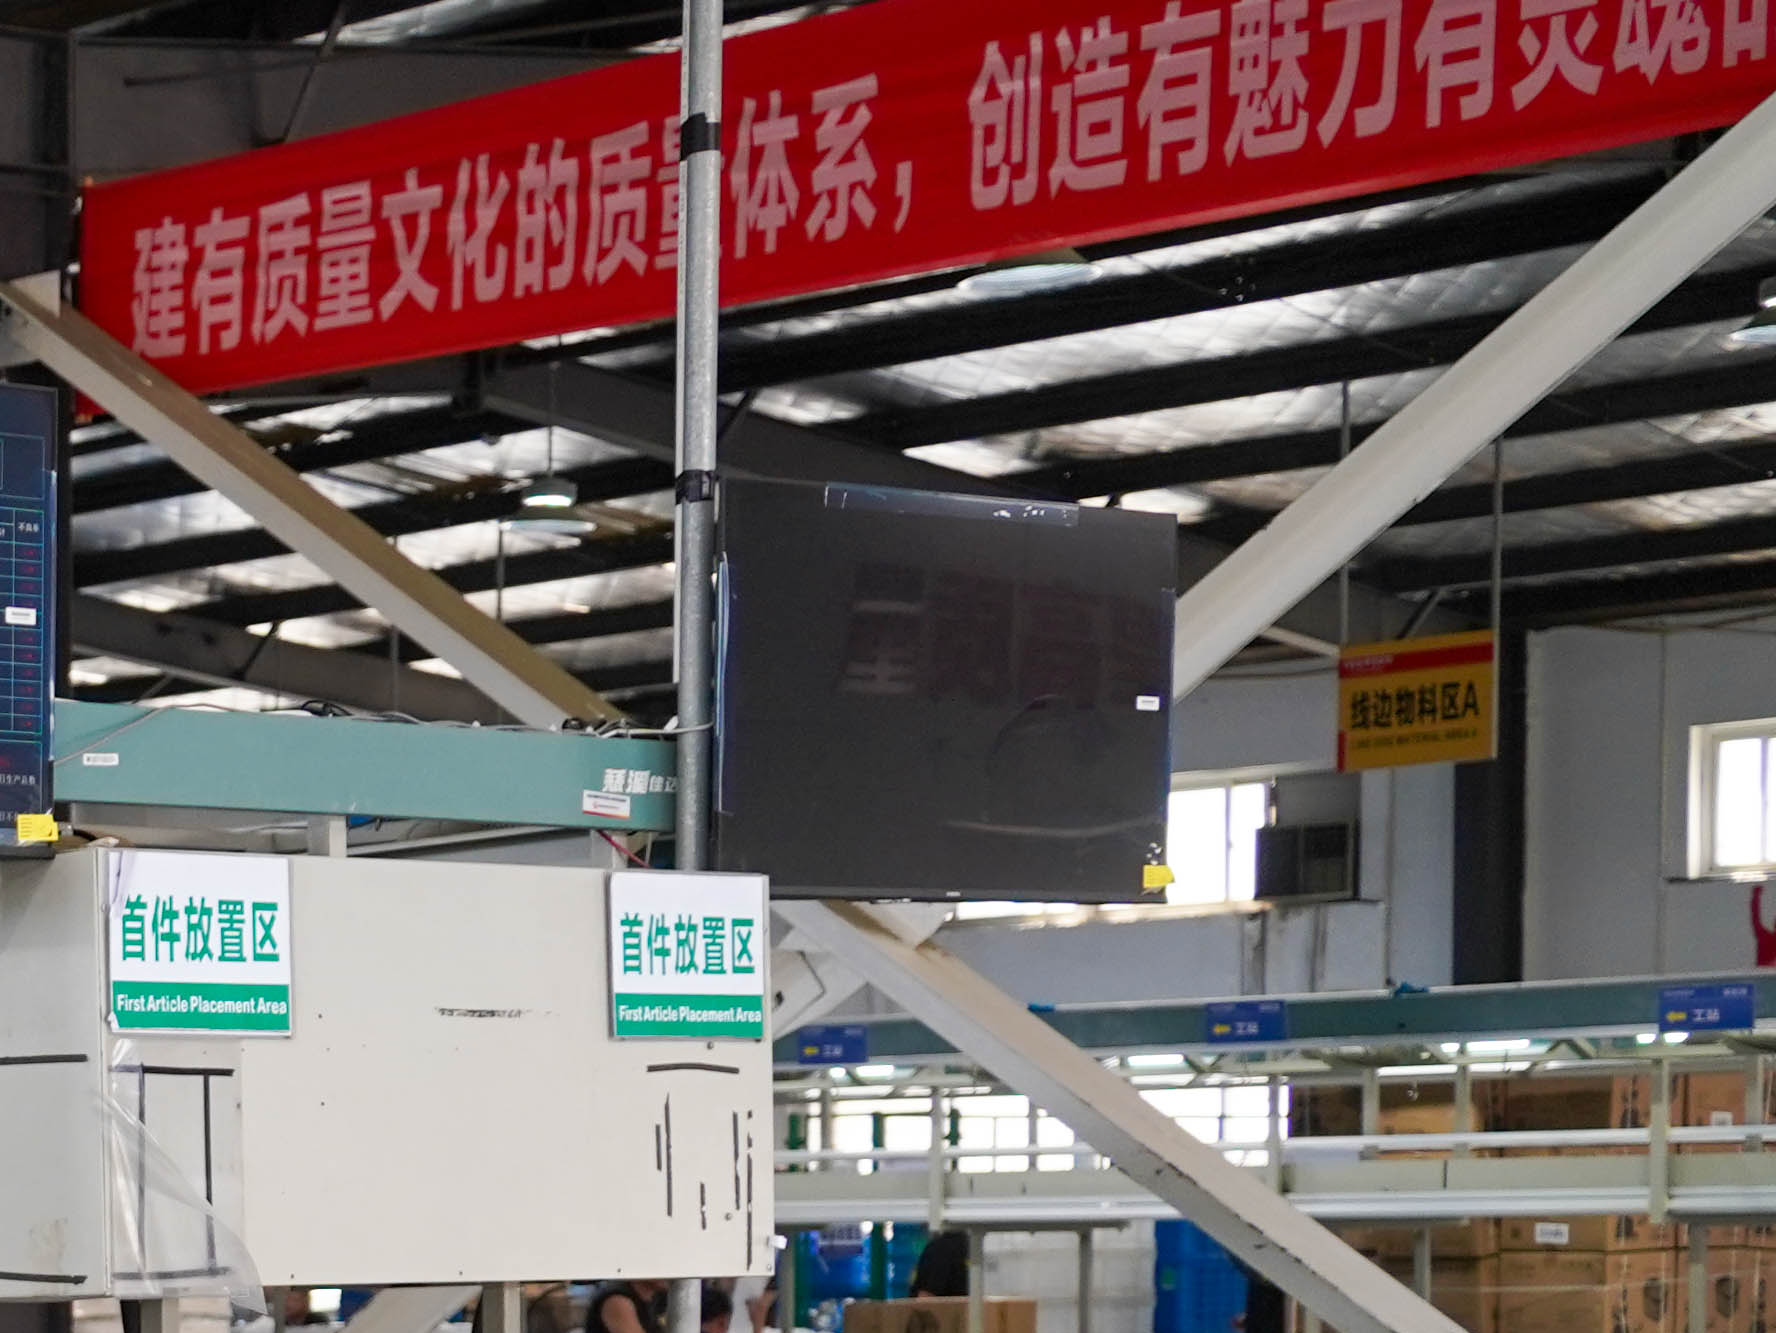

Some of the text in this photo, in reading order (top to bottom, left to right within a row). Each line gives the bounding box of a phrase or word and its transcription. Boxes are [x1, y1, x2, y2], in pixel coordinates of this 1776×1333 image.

[122, 894, 280, 963] 首件放置区
[620, 911, 756, 976] 首件放置区
[116, 994, 288, 1015] First Article Placement Area
[618, 1005, 762, 1023] First Article Placement Area
